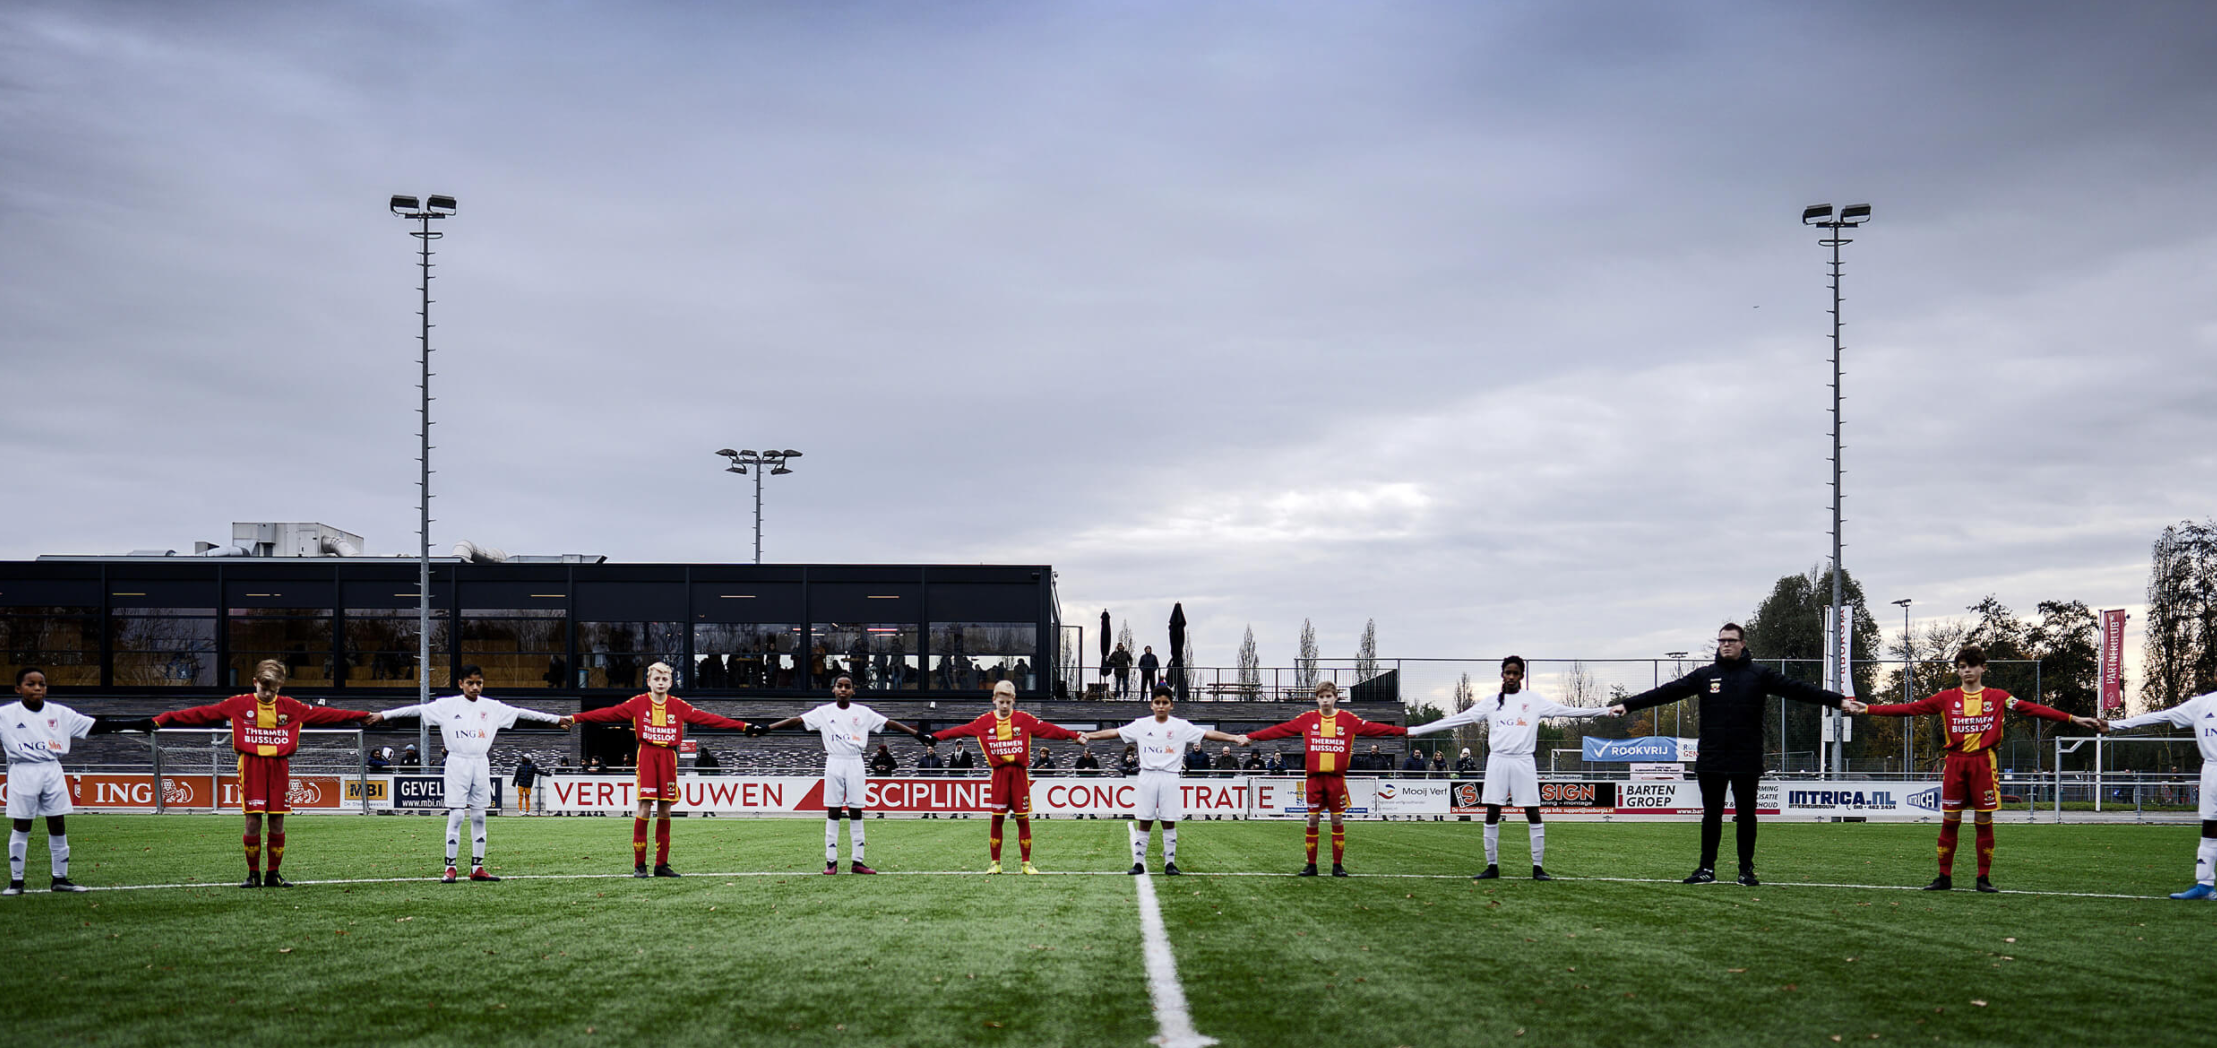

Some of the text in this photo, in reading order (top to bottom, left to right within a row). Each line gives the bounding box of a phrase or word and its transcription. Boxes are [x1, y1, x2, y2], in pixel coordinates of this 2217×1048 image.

[2106, 621, 2119, 684] PARTNERCLUB
[244, 727, 289, 737] THERMEN
[455, 730, 476, 739] ING
[643, 725, 676, 734] THERMEN
[2205, 728, 2217, 737] IN
[244, 735, 290, 745] BUSSLOO
[831, 734, 851, 742] ING
[1310, 738, 1345, 746] THERMEN
[18, 741, 46, 751] ING
[988, 740, 1023, 748] THERMEN
[1310, 744, 1345, 753] BUSSLOO
[1143, 746, 1163, 754] ING
[1611, 746, 1668, 756] ROOKVRIJ
[95, 782, 153, 804] ING
[350, 783, 383, 797] MBI
[554, 781, 783, 807] VERTUWEN
[865, 782, 992, 808] SCIPLINE
[1402, 787, 1448, 797] Mooij Verf
[1541, 784, 1596, 801] SIGN
[1626, 785, 1676, 795] BARTEN
[1047, 785, 1274, 809] CONCTRATIE
[1626, 797, 1672, 807] GROEP
